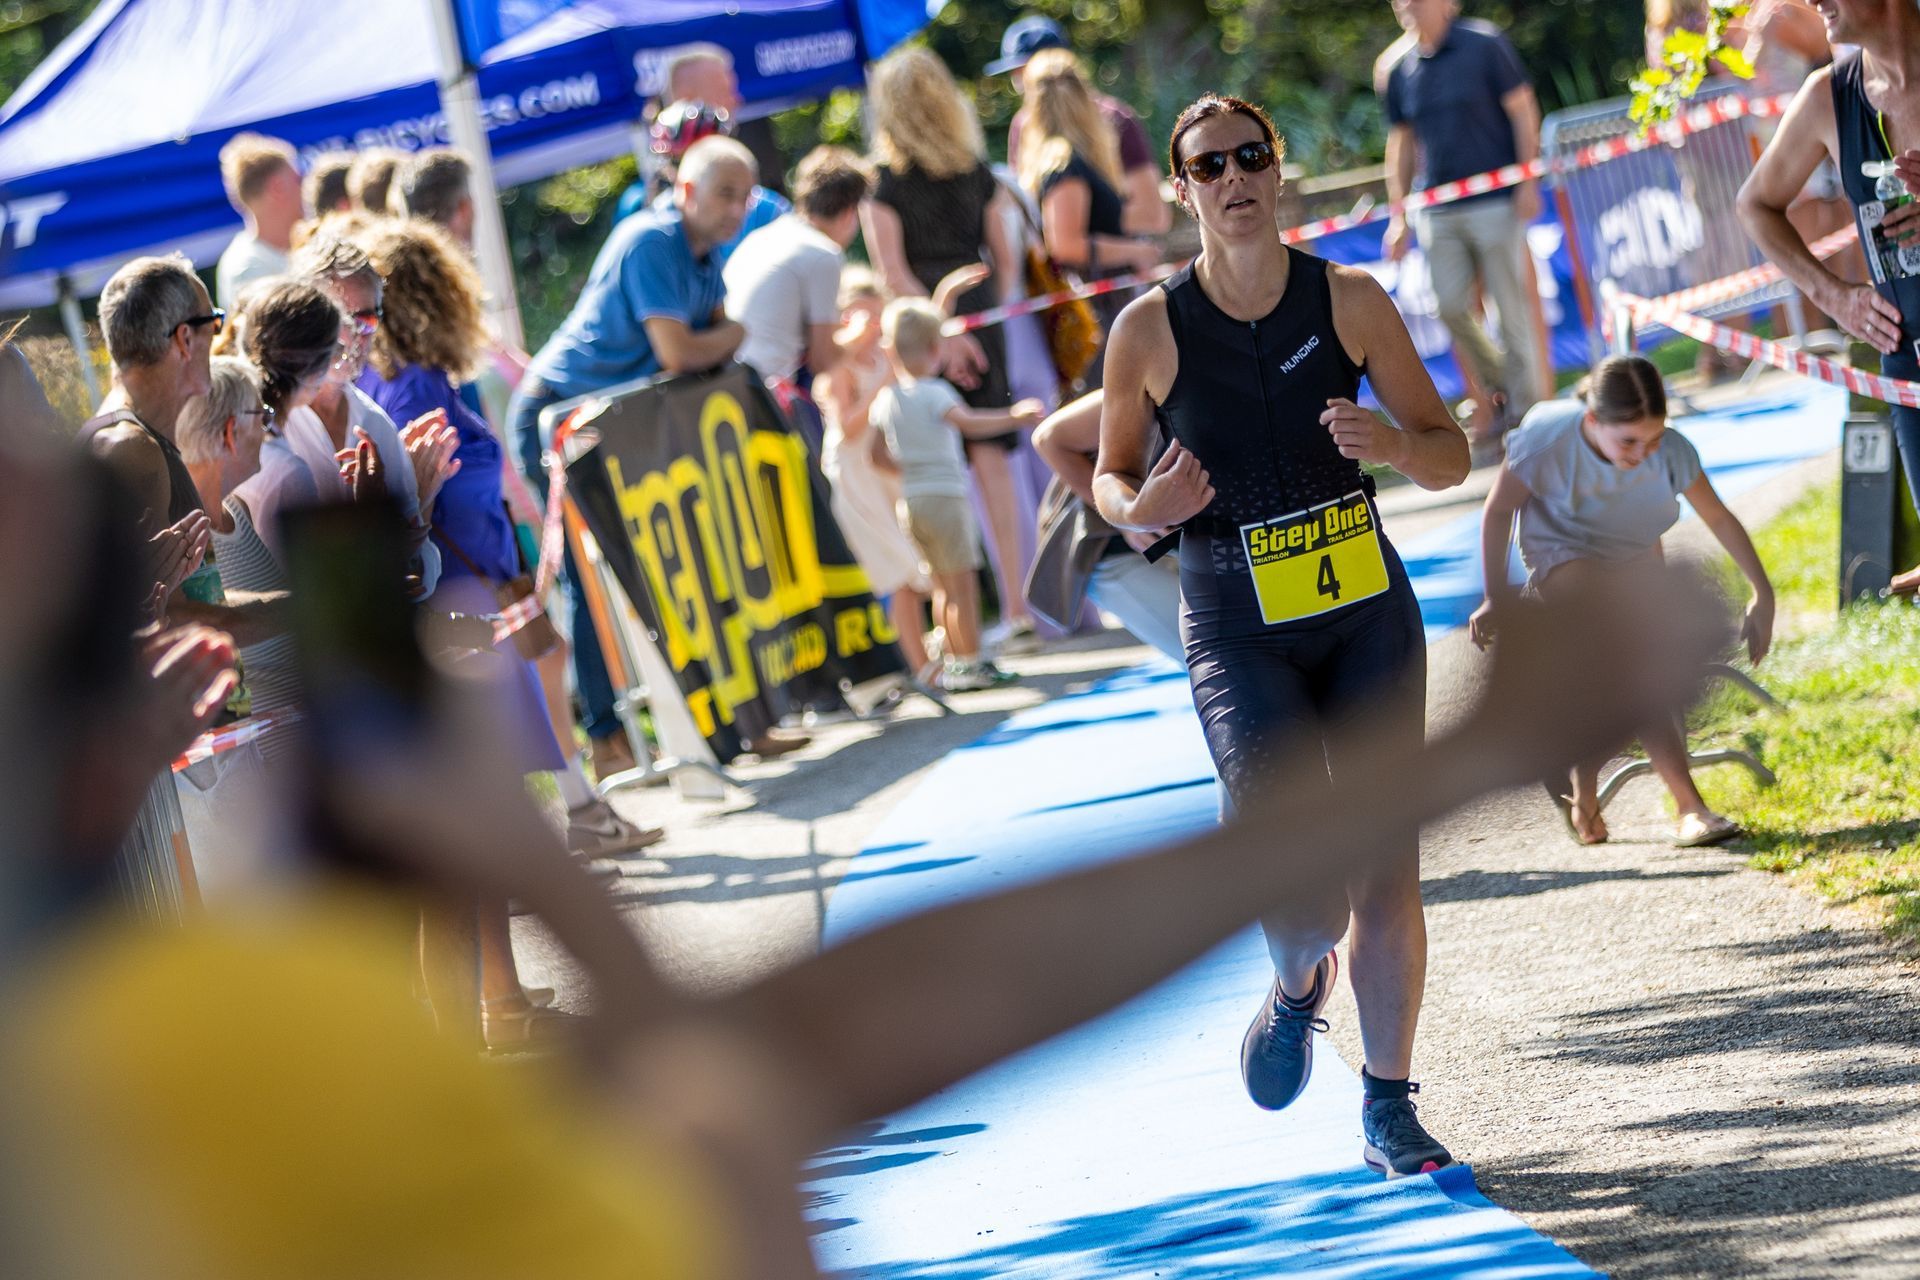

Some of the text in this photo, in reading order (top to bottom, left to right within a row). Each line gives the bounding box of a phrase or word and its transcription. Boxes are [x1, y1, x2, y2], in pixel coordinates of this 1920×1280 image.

[1250, 503, 1368, 557] Step One
[1327, 524, 1369, 544] TRAIL AND RUN
[1252, 551, 1290, 565] TRIATHLON
[1316, 554, 1341, 601] 4
